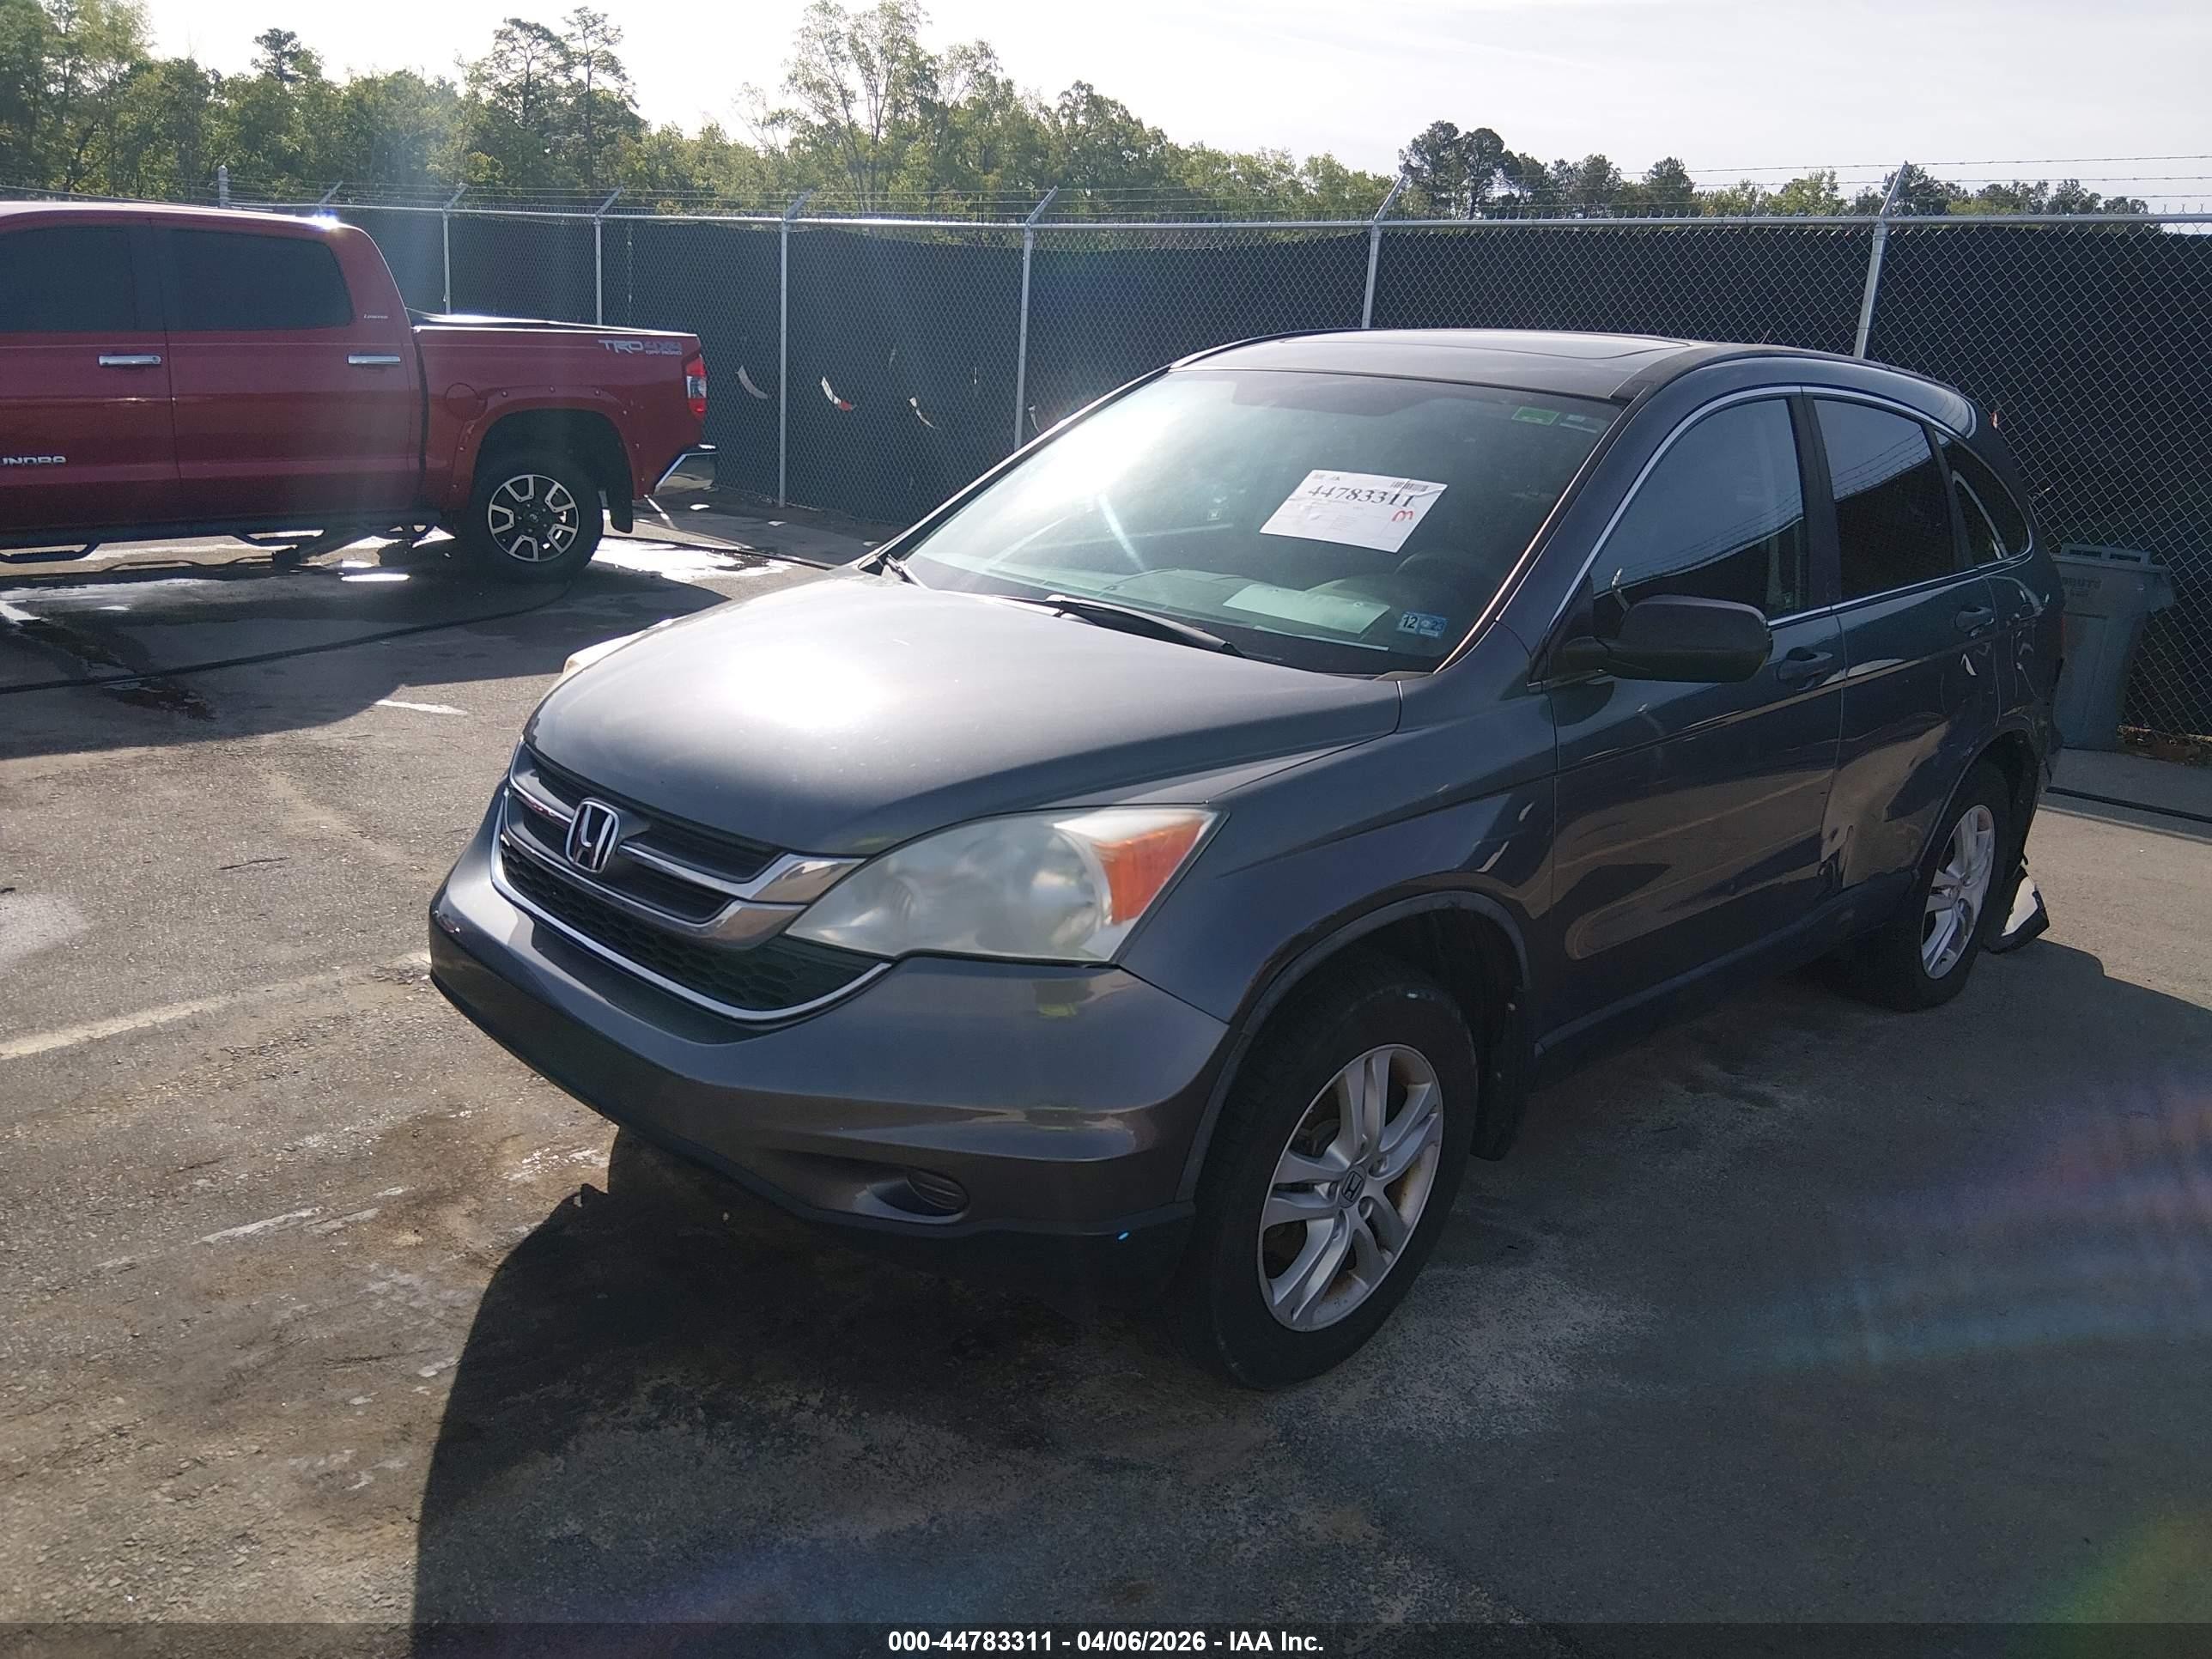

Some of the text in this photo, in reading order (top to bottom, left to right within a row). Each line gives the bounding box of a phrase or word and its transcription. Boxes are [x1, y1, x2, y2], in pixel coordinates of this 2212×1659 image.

[598, 339, 644, 354] TRD
[1308, 485, 1415, 507] 44783311
[1402, 615, 1419, 629] 12
